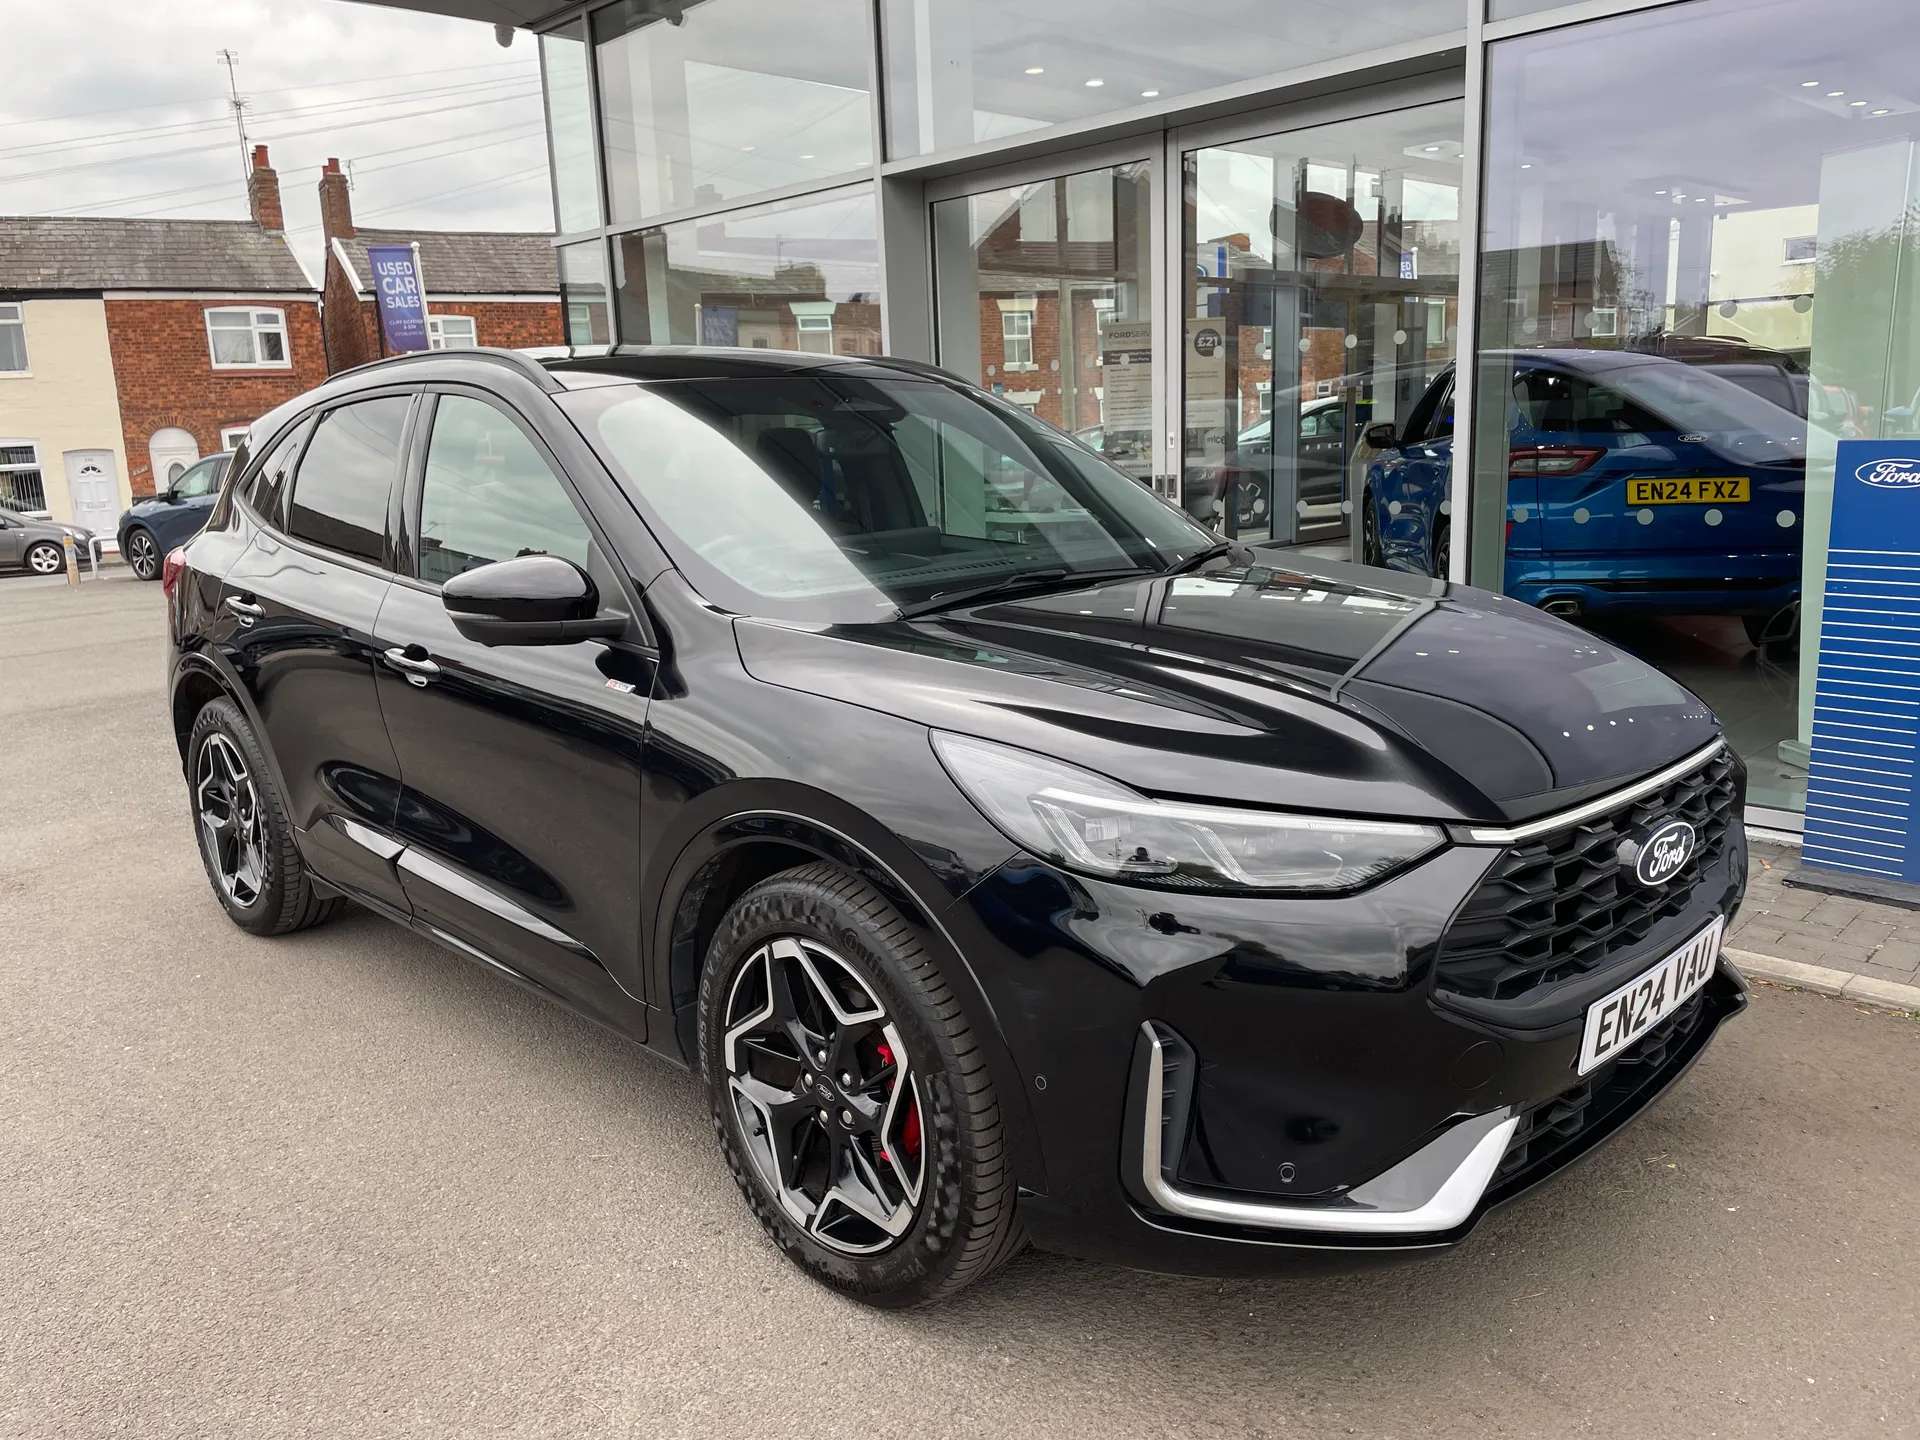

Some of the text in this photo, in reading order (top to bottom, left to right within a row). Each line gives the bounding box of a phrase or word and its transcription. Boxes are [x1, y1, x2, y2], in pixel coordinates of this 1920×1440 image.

[377, 262, 413, 275] USED
[383, 277, 418, 294] CAR
[386, 296, 421, 309] SALES
[1636, 480, 1740, 501] EN24 FXZ
[1649, 832, 1687, 878] Ford
[1594, 930, 1715, 1058] EN24 VAU
